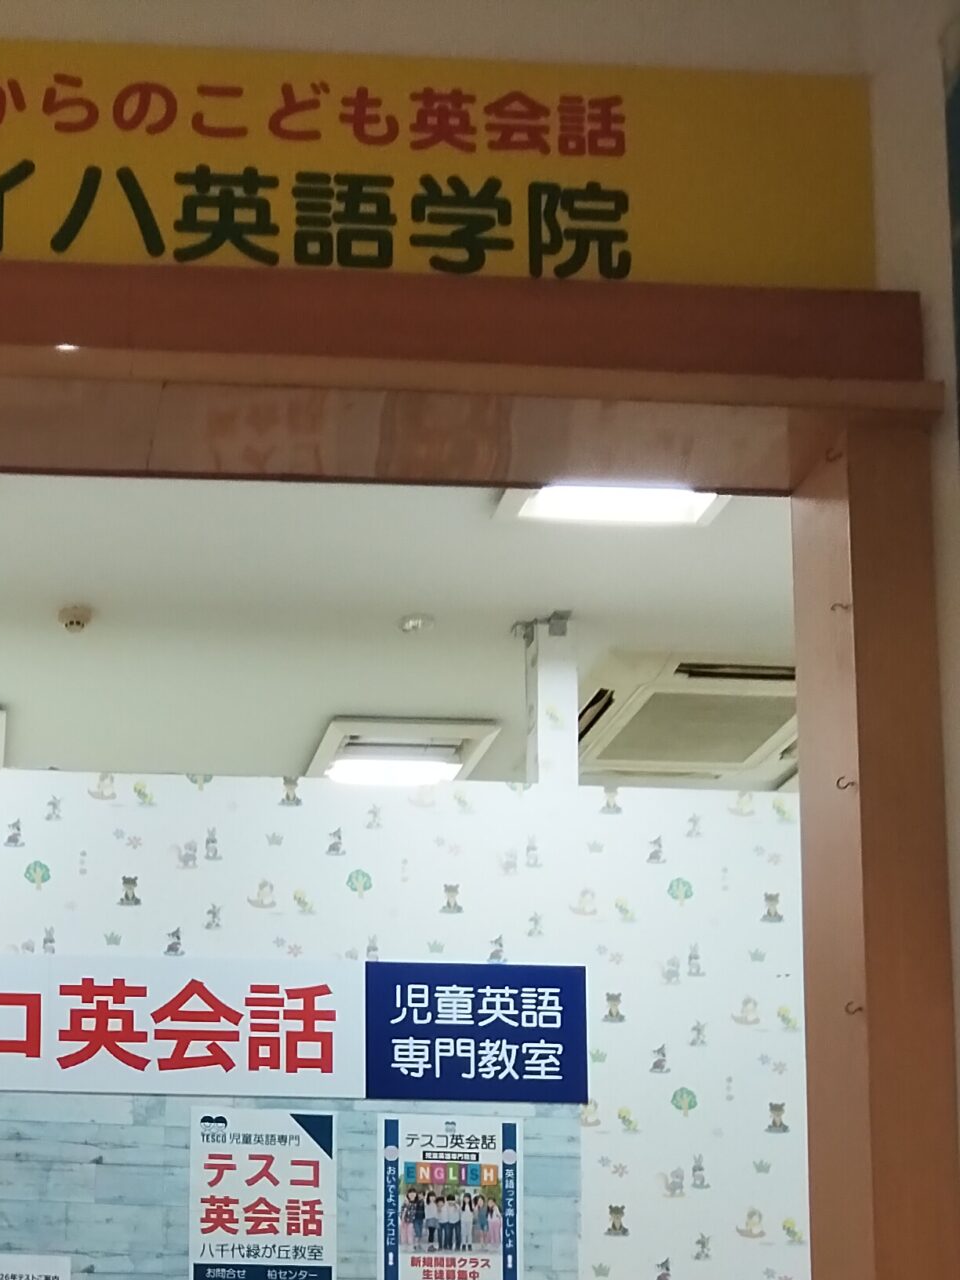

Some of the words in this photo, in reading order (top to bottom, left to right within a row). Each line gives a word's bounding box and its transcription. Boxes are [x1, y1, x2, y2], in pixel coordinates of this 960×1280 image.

[392, 983, 565, 1031] 児童英語
[390, 1035, 565, 1082] 専門教室
[201, 1133, 227, 1143] TESCO
[230, 1132, 301, 1147] 児童英語専門
[405, 1133, 497, 1151] テスコ英会話
[203, 1153, 321, 1189] テスコ
[406, 1164, 496, 1185] ENGLISH
[199, 1196, 325, 1238] 英会話
[200, 1243, 324, 1261] 八千代緑が丘教室
[205, 1268, 247, 1279] お問合せ
[267, 1269, 318, 1280] 柏センター
